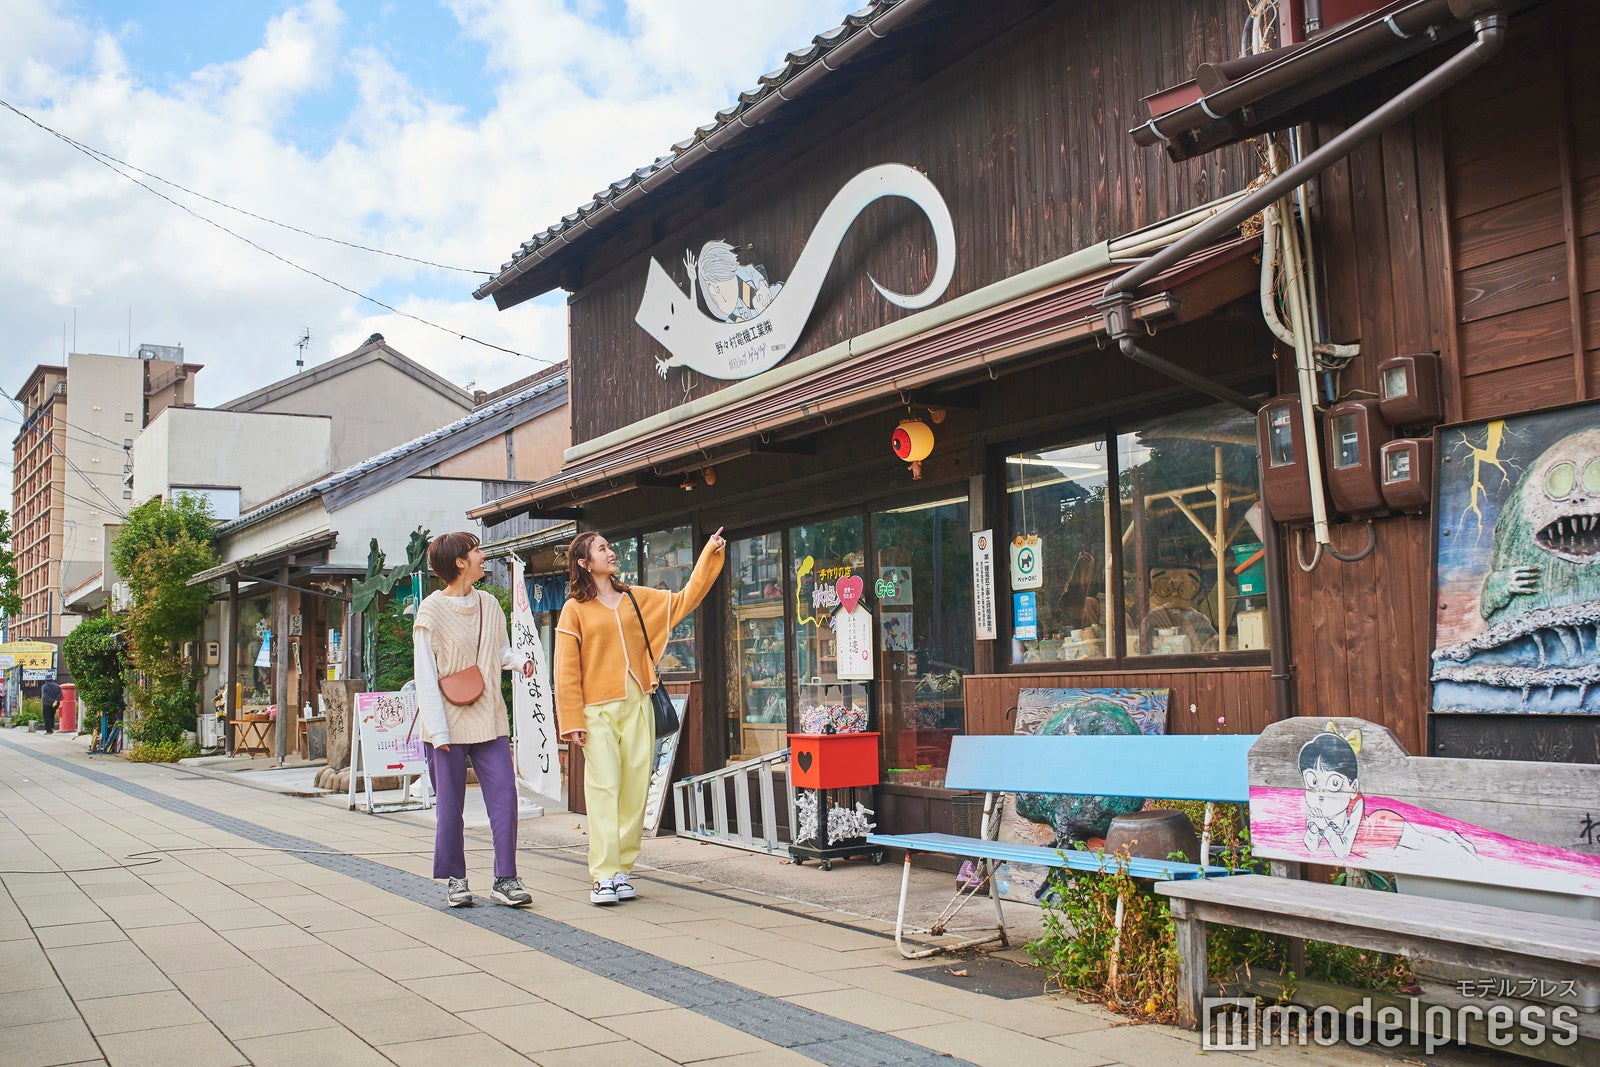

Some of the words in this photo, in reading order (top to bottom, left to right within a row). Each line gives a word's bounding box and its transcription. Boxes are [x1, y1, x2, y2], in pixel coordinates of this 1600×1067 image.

[819, 566, 852, 580] 手作りの店
